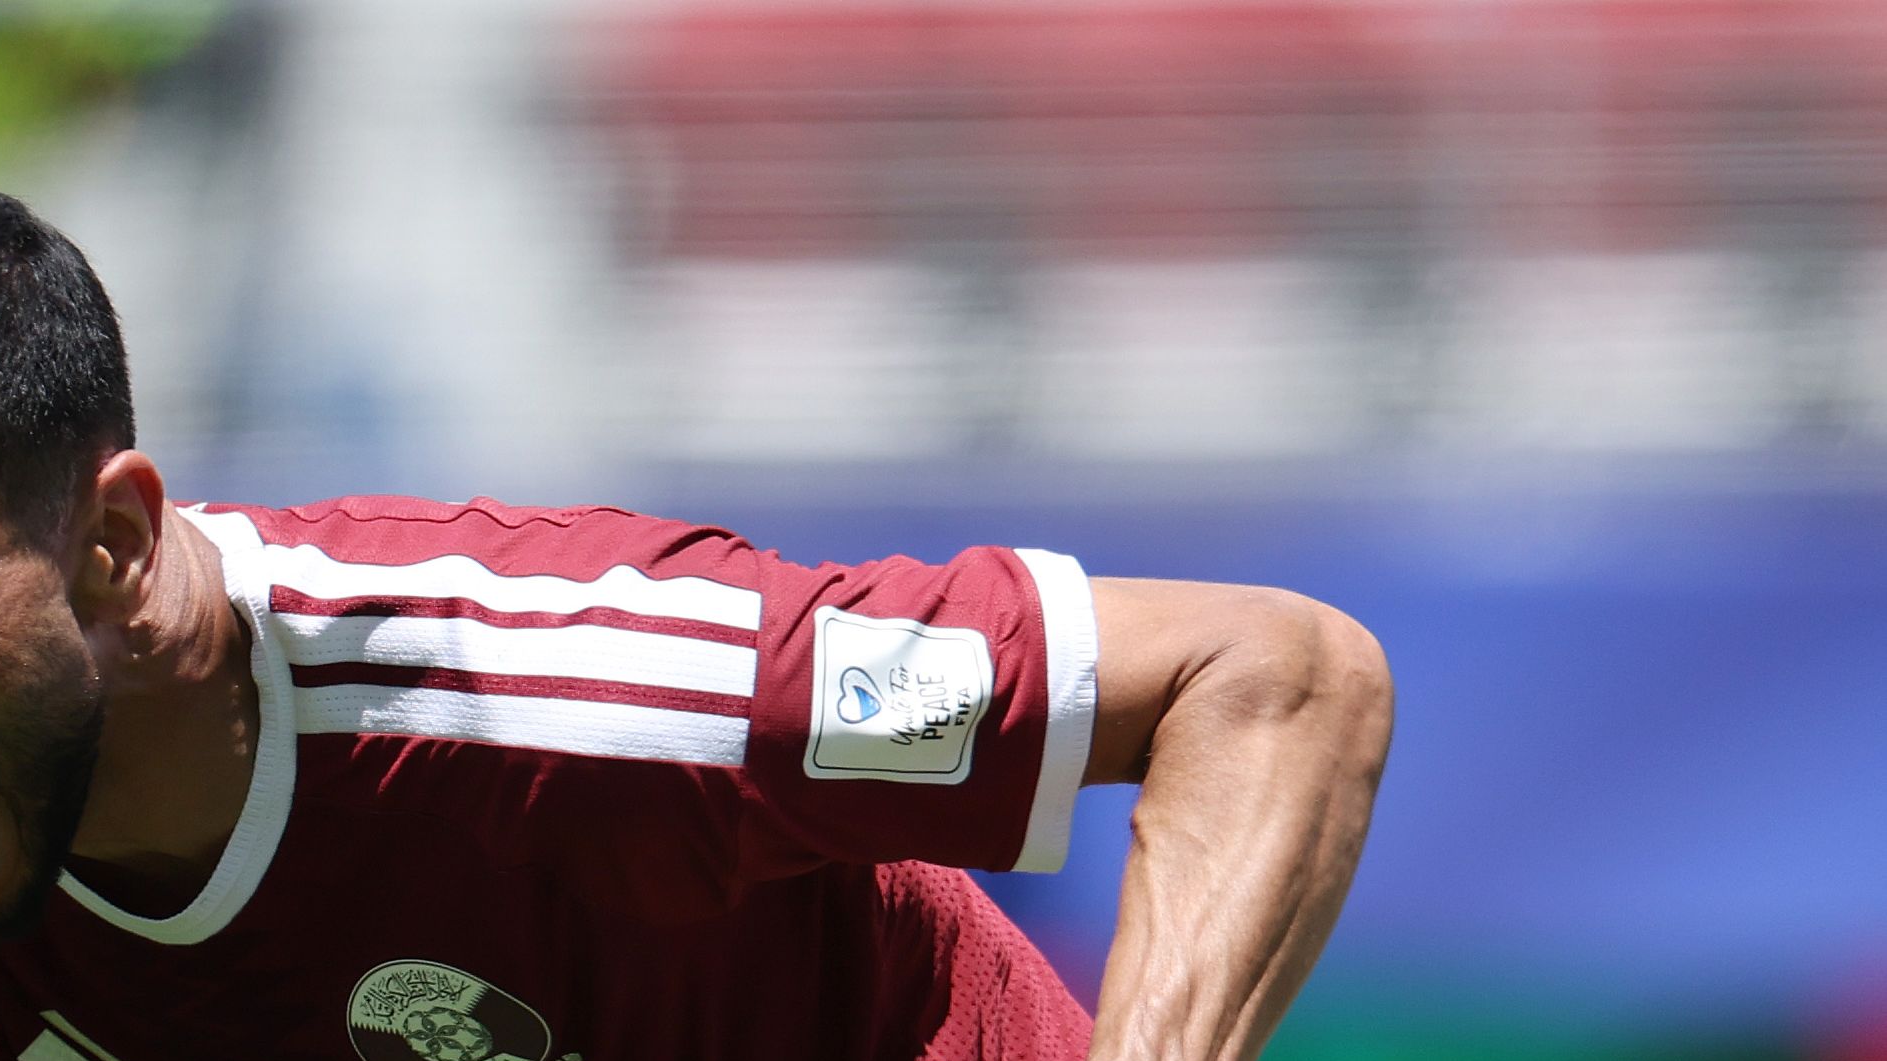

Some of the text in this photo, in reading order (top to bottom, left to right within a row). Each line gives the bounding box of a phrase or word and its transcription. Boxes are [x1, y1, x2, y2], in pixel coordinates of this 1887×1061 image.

[889, 663, 912, 693] For
[917, 674, 951, 740] PEACE
[953, 687, 971, 727] FIFA
